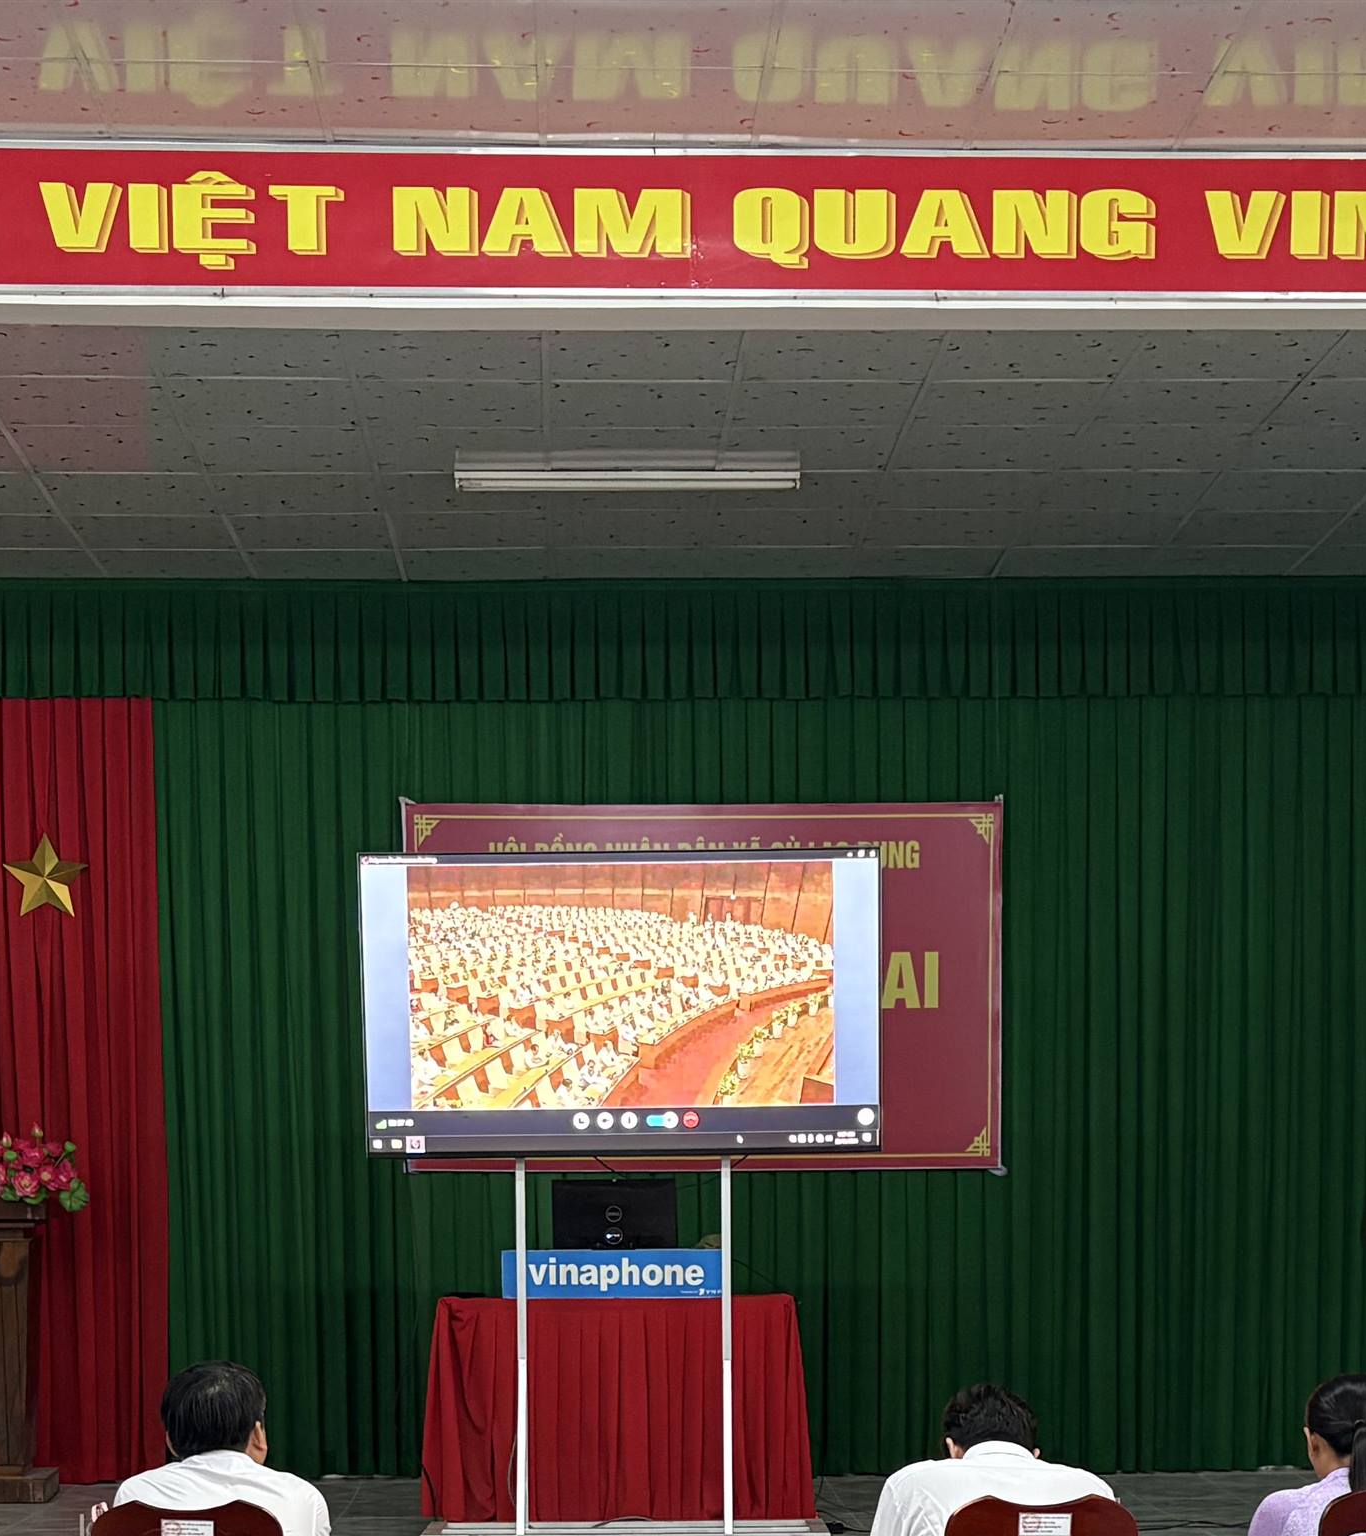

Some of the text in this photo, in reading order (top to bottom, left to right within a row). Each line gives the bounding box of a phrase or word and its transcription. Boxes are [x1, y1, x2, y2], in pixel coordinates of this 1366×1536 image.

[40, 169, 343, 270] VIỆT
[393, 186, 690, 258] NAM
[733, 187, 1155, 270] QUANG
[528, 1257, 705, 1291] vinaphone
